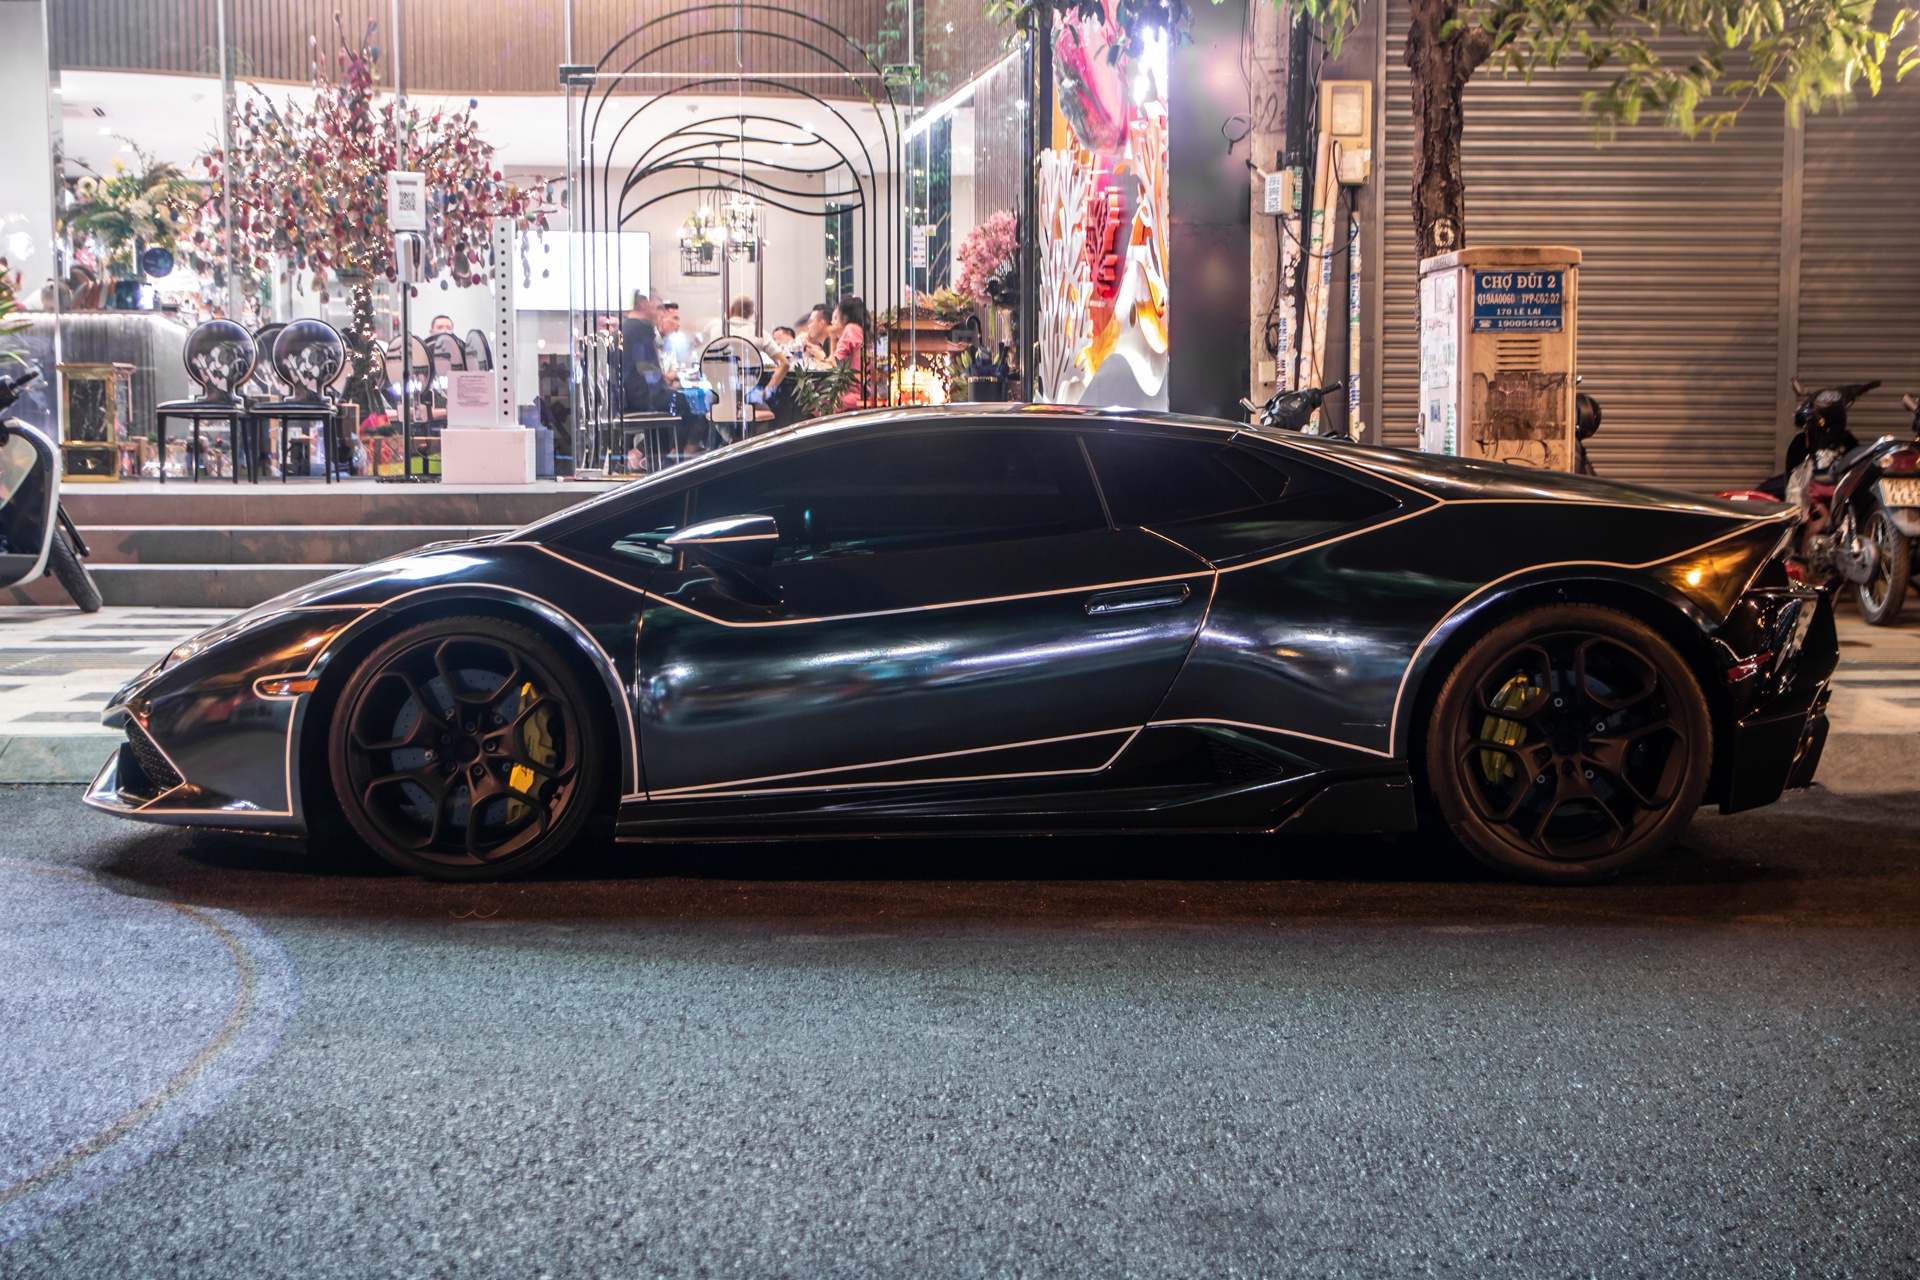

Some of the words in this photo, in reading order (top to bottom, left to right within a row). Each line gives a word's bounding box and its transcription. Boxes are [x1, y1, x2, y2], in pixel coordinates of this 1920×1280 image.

[1481, 273, 1513, 292] CHỢ
[1516, 272, 1543, 289] ĐŨI
[1547, 275, 1556, 289] 2
[1496, 308, 1512, 316] 170
[1527, 308, 1541, 316] LAI
[1497, 319, 1557, 328] 1900545454
